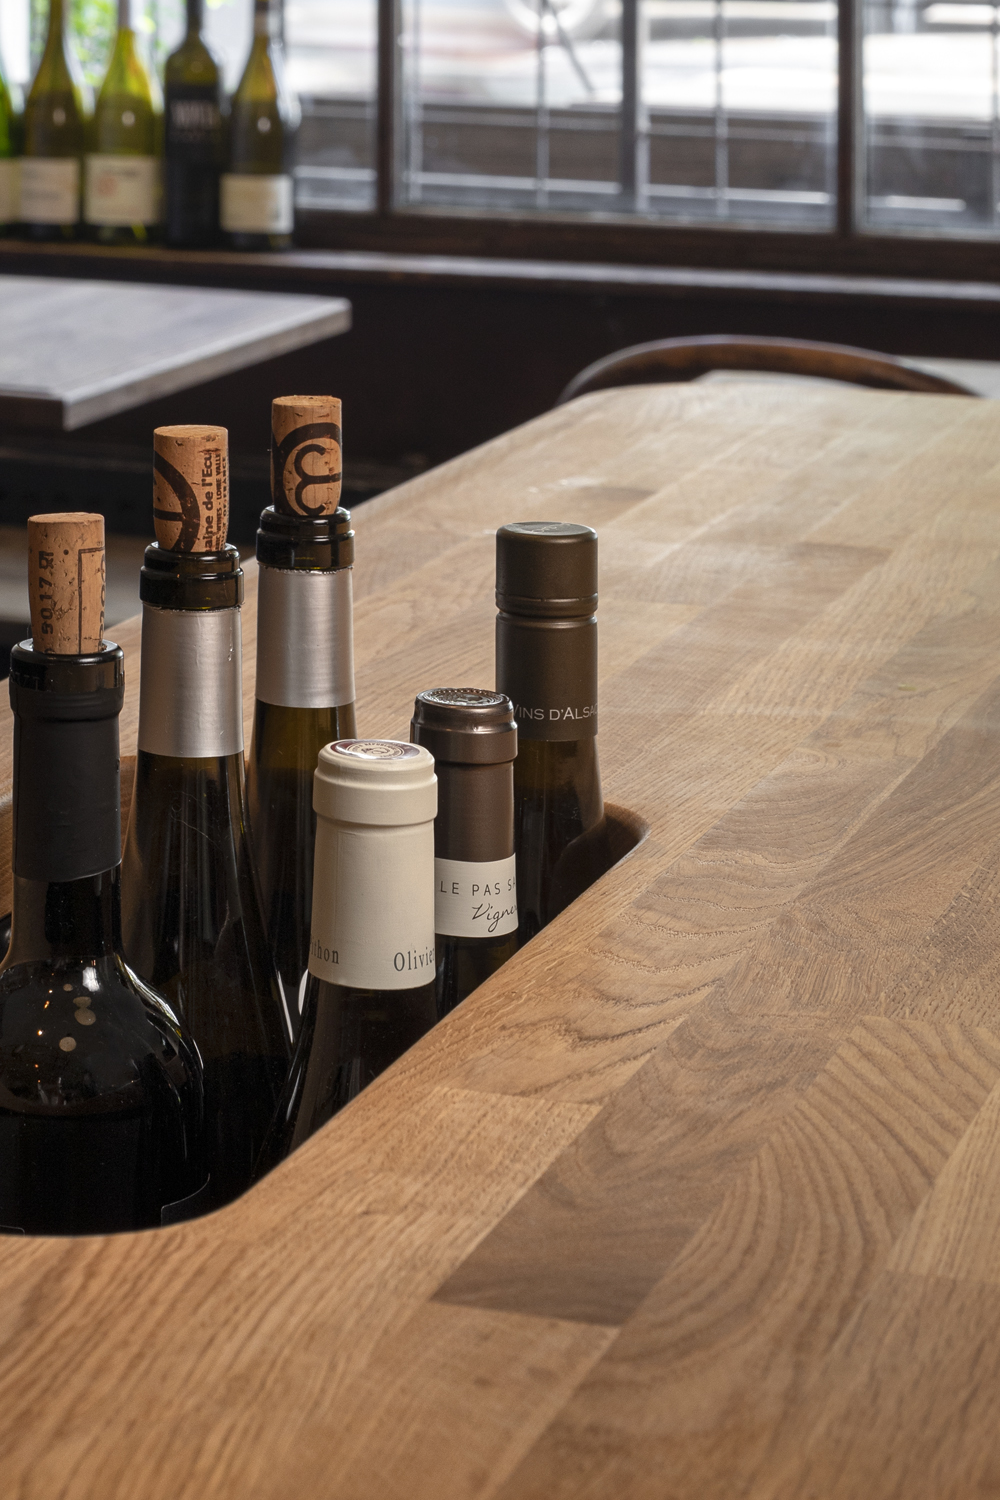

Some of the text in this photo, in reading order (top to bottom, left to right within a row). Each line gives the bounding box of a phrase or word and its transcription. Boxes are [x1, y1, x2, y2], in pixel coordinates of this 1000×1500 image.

[202, 491, 214, 511] de
[203, 515, 214, 552] aine
[440, 880, 460, 895] LE
[472, 882, 501, 897] PAS
[309, 937, 340, 965] ithon
